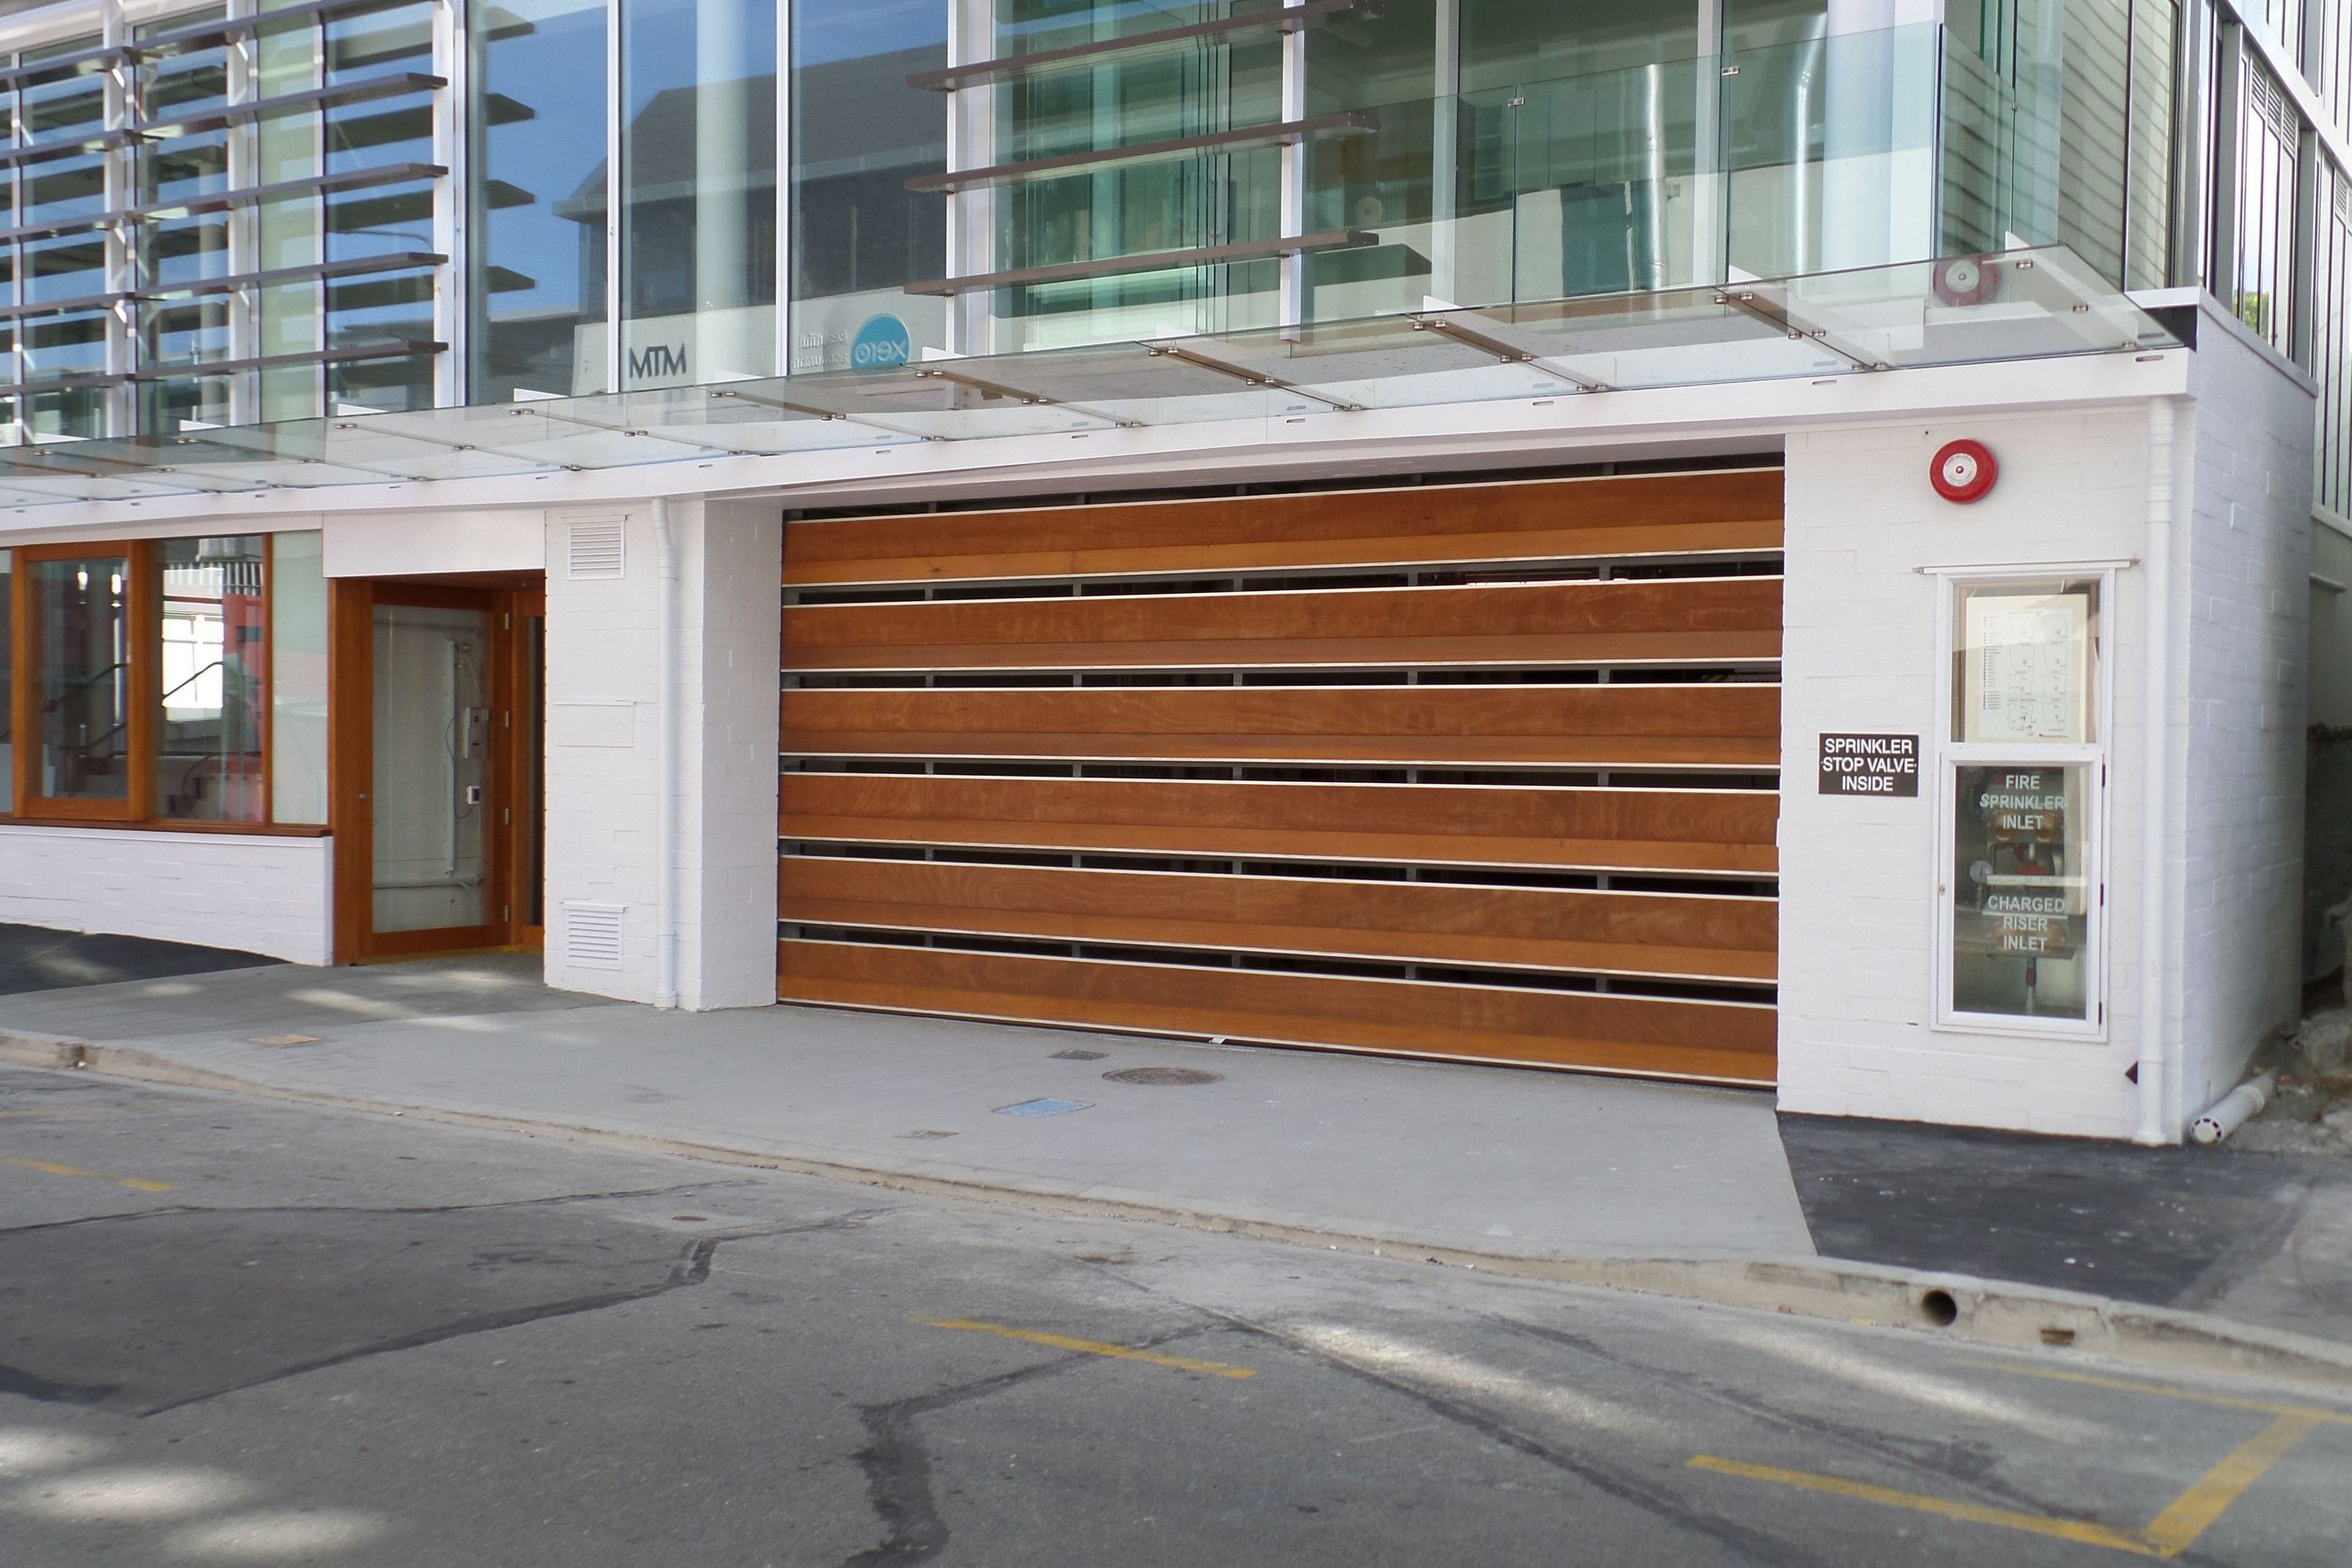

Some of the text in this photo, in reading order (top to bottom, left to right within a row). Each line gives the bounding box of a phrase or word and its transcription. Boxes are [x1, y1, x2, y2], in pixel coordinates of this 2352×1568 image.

[629, 342, 687, 379] MTM
[1825, 738, 1912, 754] SPRINKLER
[1822, 756, 1915, 772] STOP VALVE
[1842, 776, 1893, 791] INSIDE
[2006, 775, 2040, 789] FIRE
[1979, 794, 2065, 809] SPRINKLER
[2002, 815, 2044, 829] INLET
[1987, 895, 2065, 913] CHARGED
[2003, 916, 2048, 932] RISER
[2003, 935, 2047, 952] INLET
